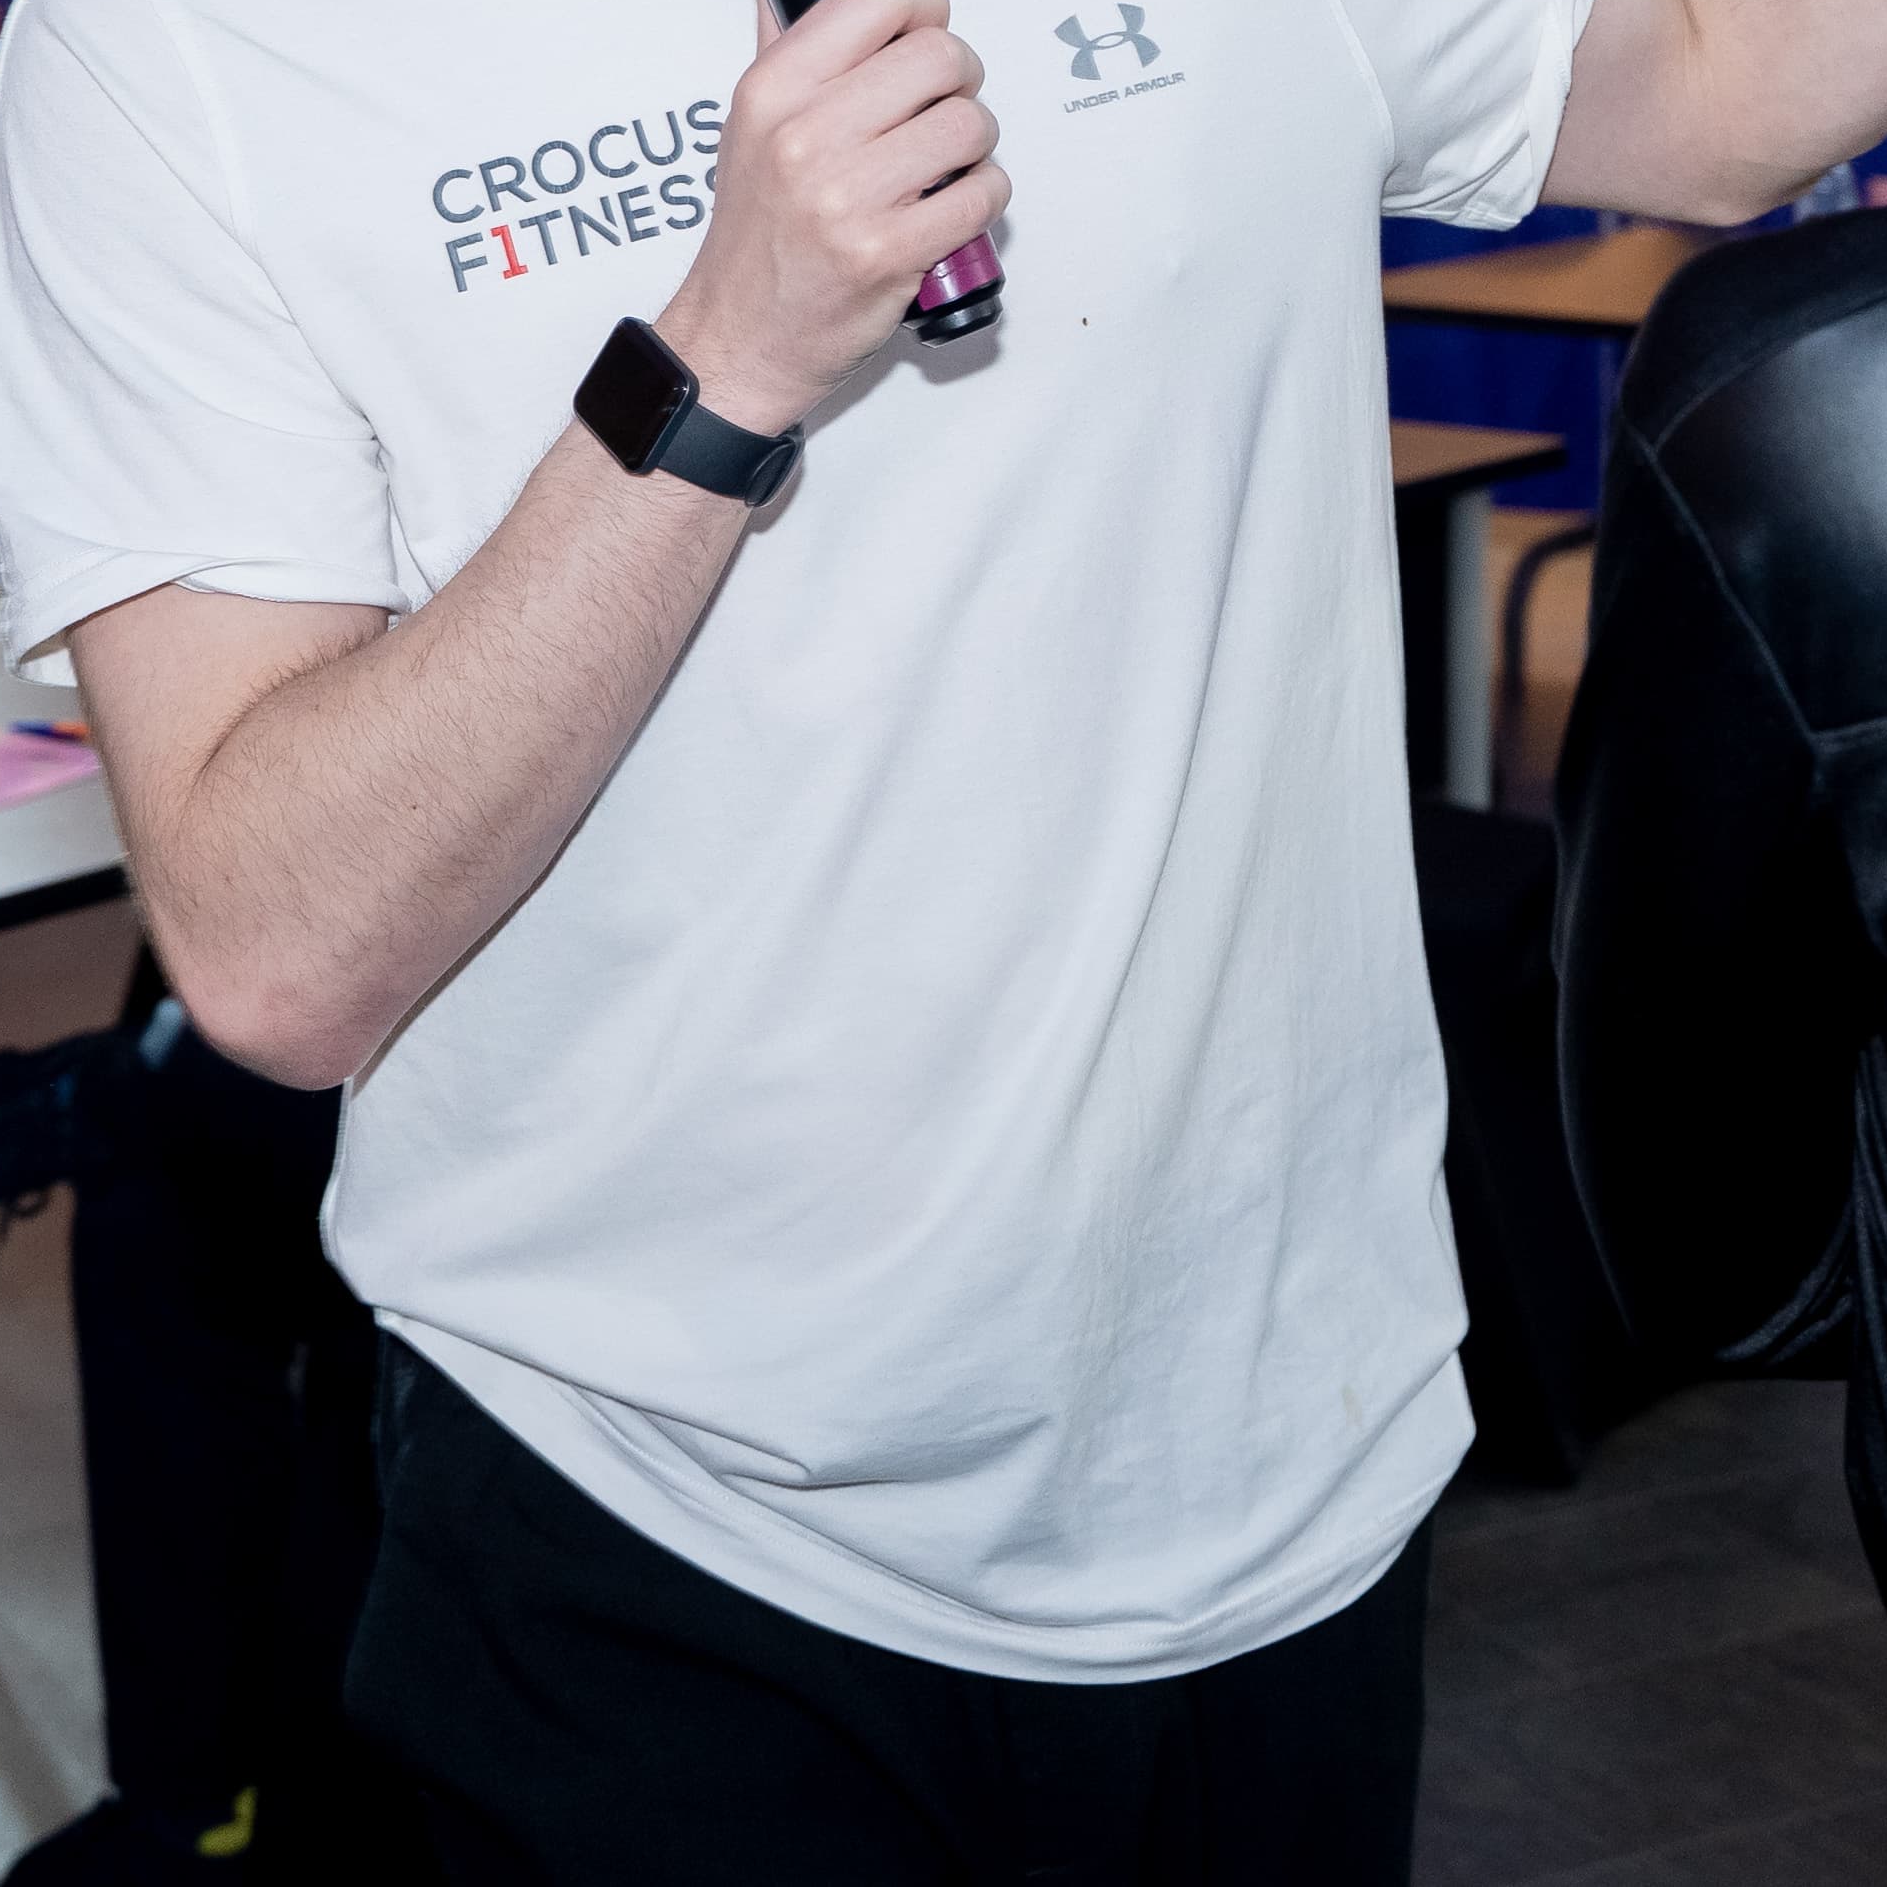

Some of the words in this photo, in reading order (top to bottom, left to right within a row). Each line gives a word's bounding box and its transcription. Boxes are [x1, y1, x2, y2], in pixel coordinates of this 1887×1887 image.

[1064, 90, 1120, 113] UNDER
[1124, 72, 1186, 98] ARMOUR
[432, 99, 724, 224] CROCUS
[445, 165, 716, 293] F1TNES
